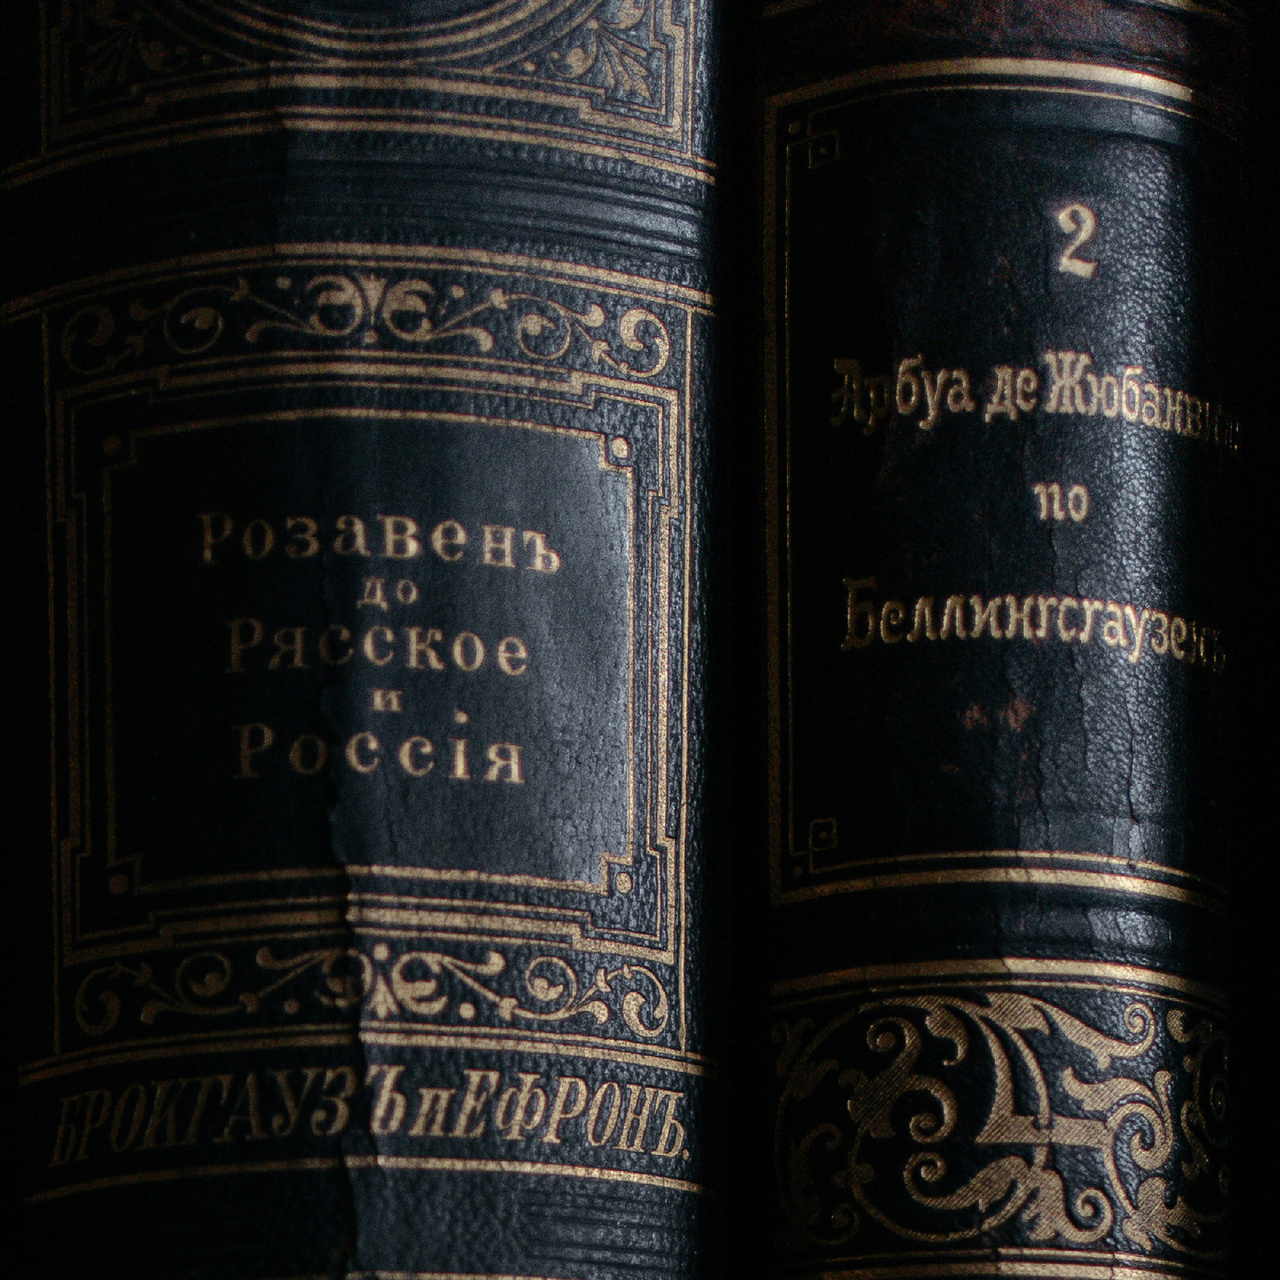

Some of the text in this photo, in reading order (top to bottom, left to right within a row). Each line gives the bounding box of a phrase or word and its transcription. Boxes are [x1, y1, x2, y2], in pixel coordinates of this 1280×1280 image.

[1058, 203, 1098, 279] 2
[984, 365, 1039, 423] де
[1034, 482, 1091, 523] по
[196, 511, 563, 575] Розавенъ
[356, 575, 419, 612] до
[224, 615, 529, 676] Рясское
[370, 687, 404, 713] и
[231, 708, 526, 785] Россія
